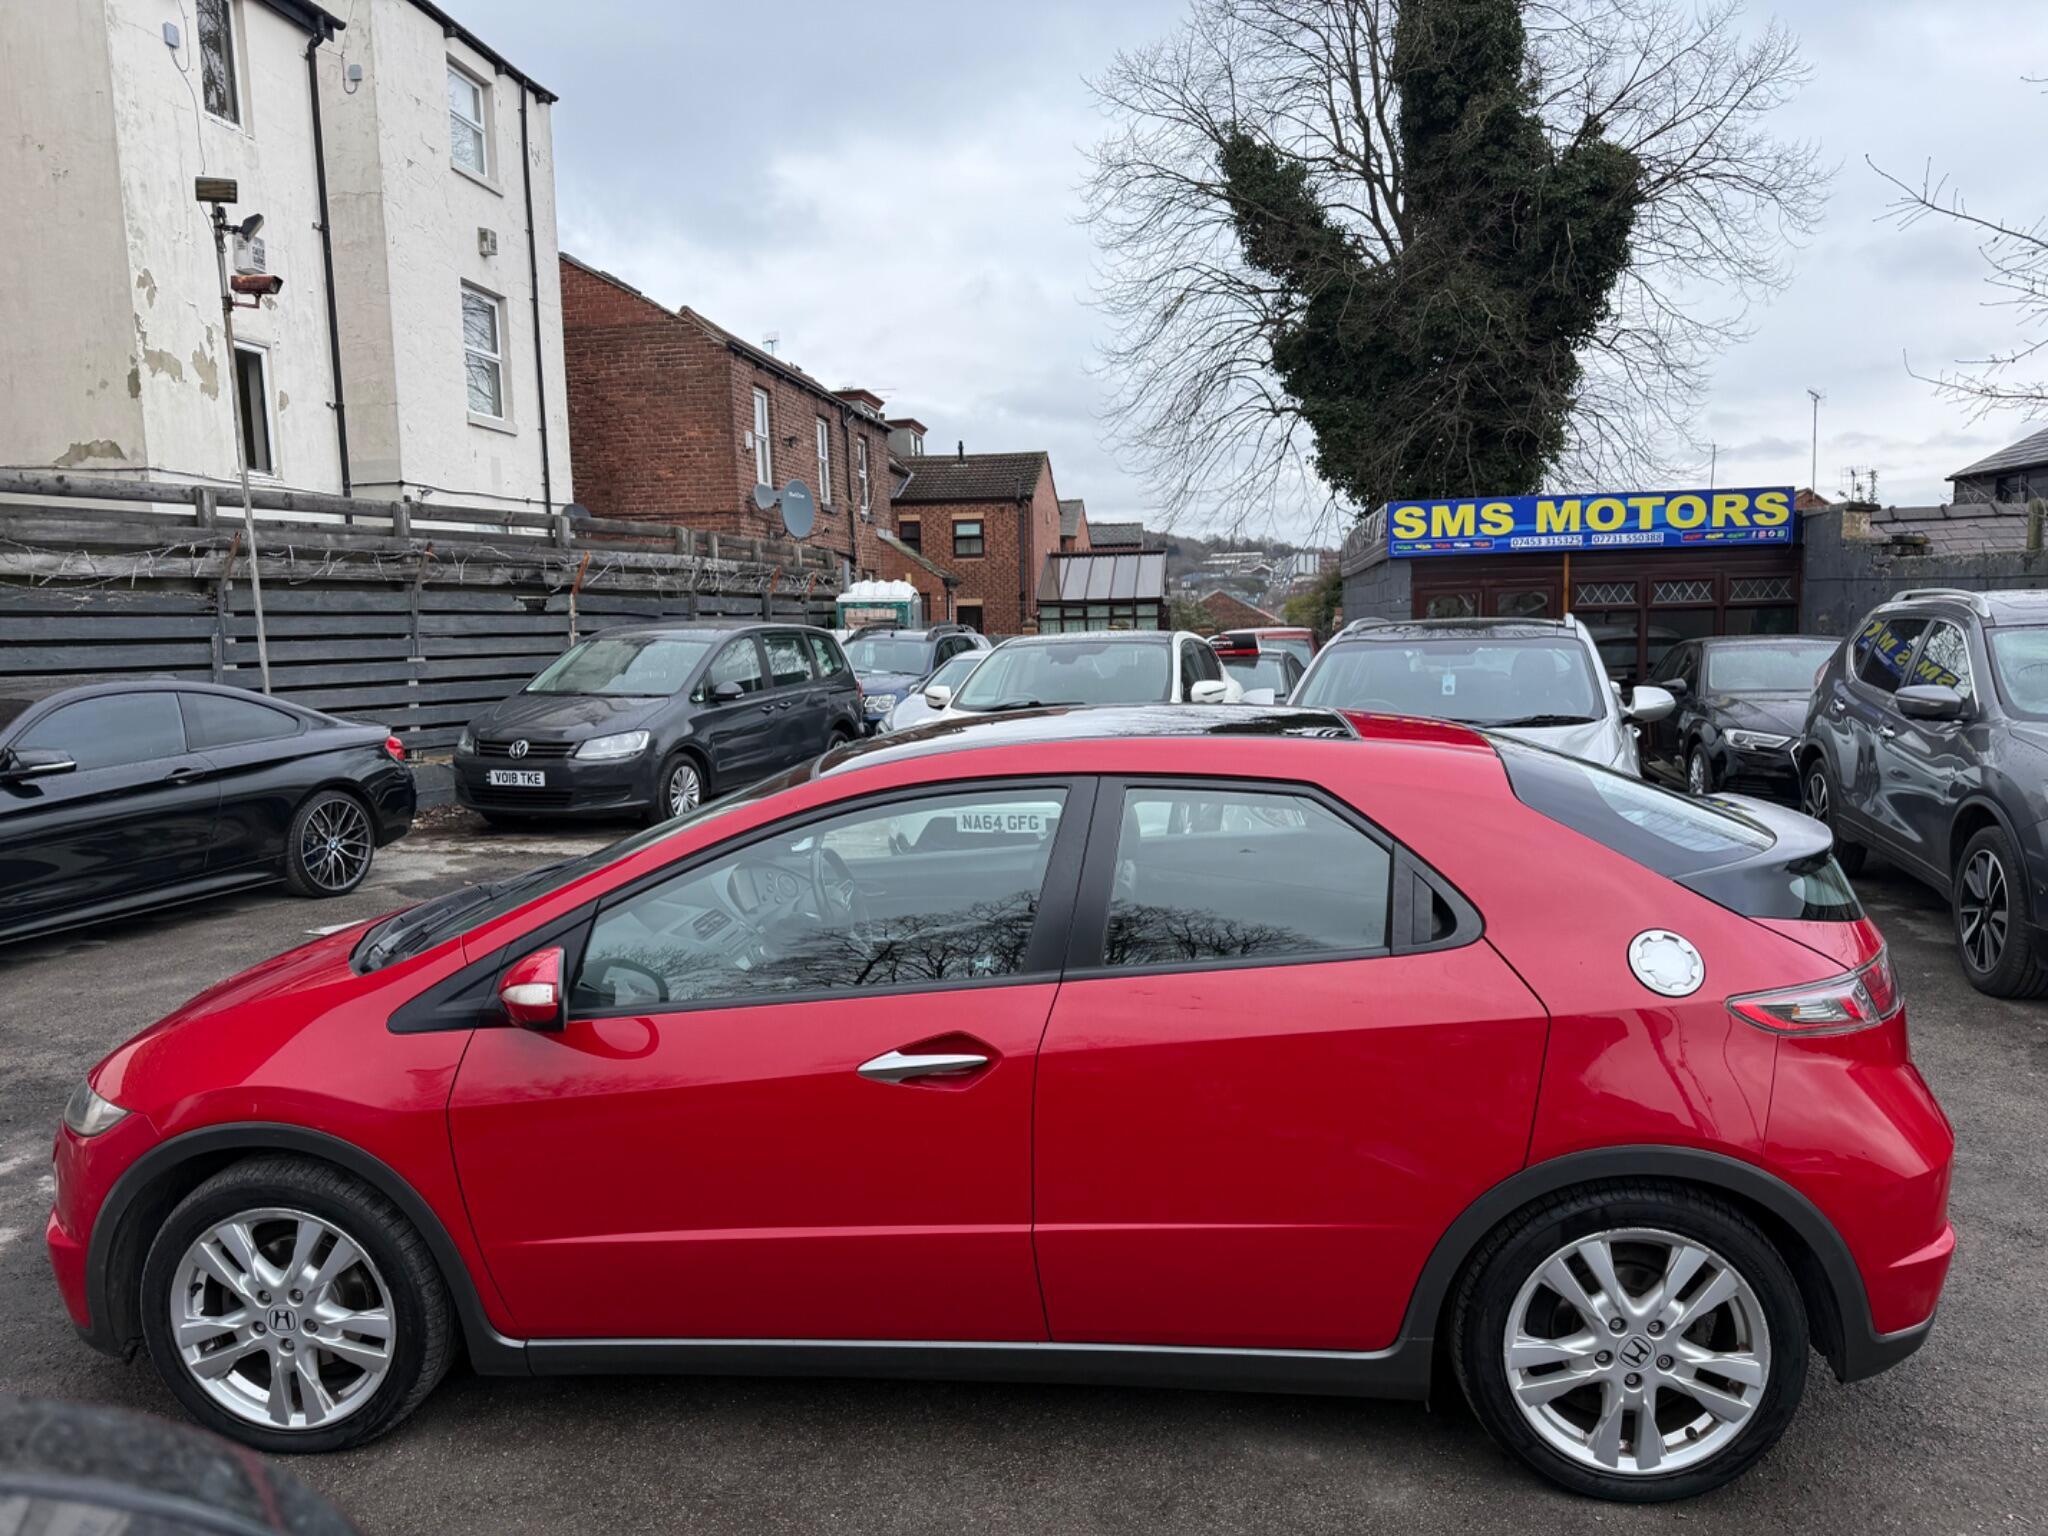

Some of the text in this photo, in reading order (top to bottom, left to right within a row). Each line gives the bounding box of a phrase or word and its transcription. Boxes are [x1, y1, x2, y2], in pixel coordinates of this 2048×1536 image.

[1392, 492, 1790, 539] SMS MOTORS
[520, 773, 541, 784] TKE
[962, 814, 1039, 830] NA64 GFG
